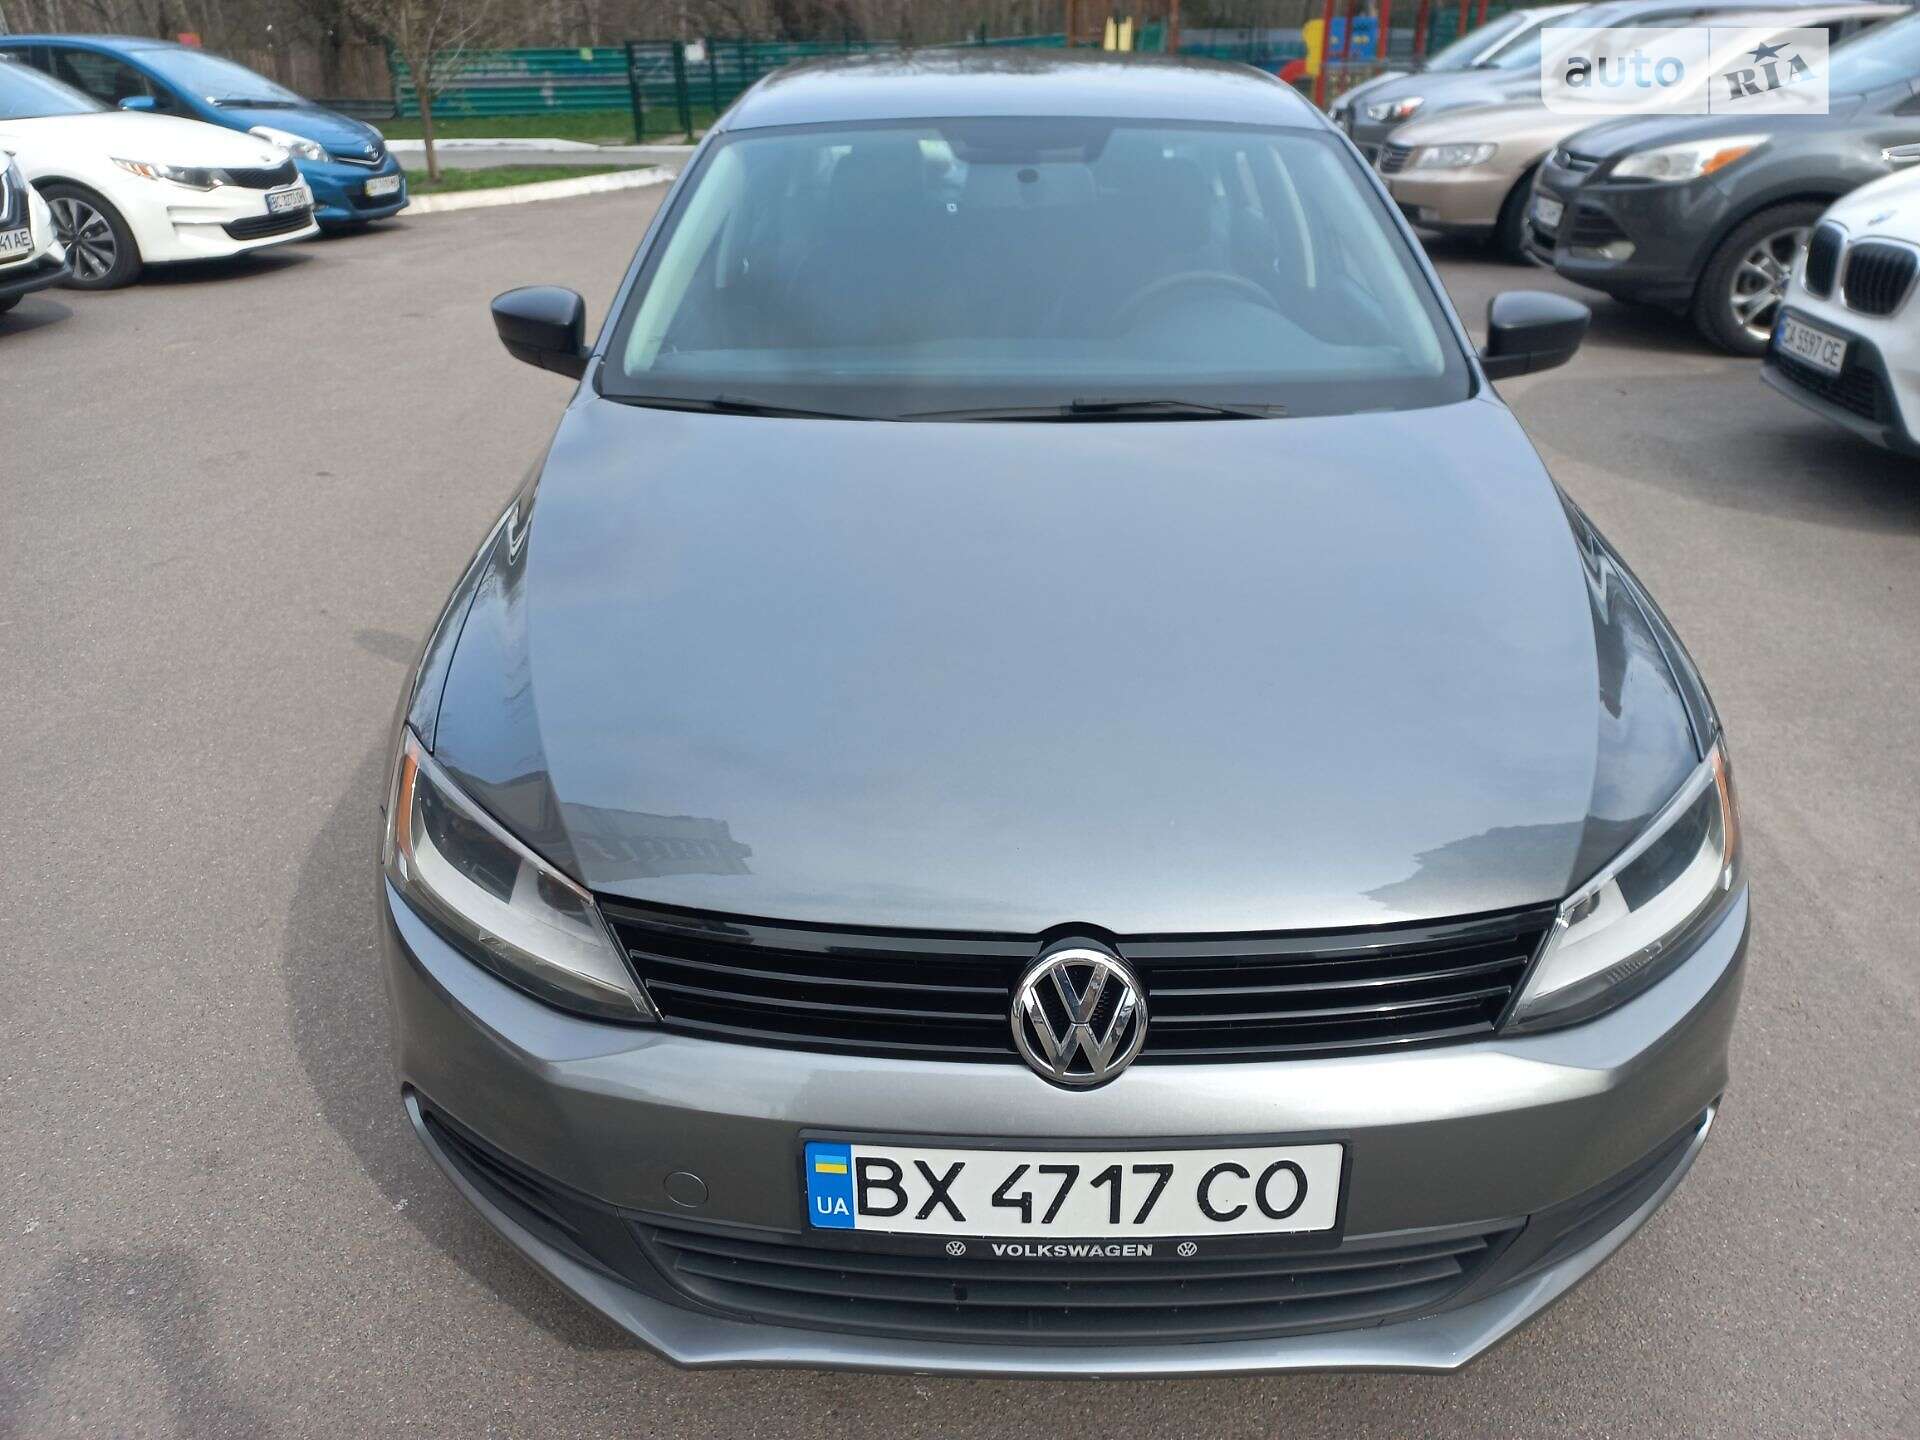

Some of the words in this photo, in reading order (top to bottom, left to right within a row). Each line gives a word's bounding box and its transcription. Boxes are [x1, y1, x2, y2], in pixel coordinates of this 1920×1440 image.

[14, 231, 30, 248] AE
[1796, 328, 1822, 357] 5597
[1823, 341, 1841, 366] CE
[817, 1197, 849, 1215] UA
[856, 1157, 966, 1222] BX
[992, 1163, 1174, 1225] 4717
[1197, 1159, 1309, 1223] CO
[992, 1243, 1153, 1257] VOLKSWAGEN
